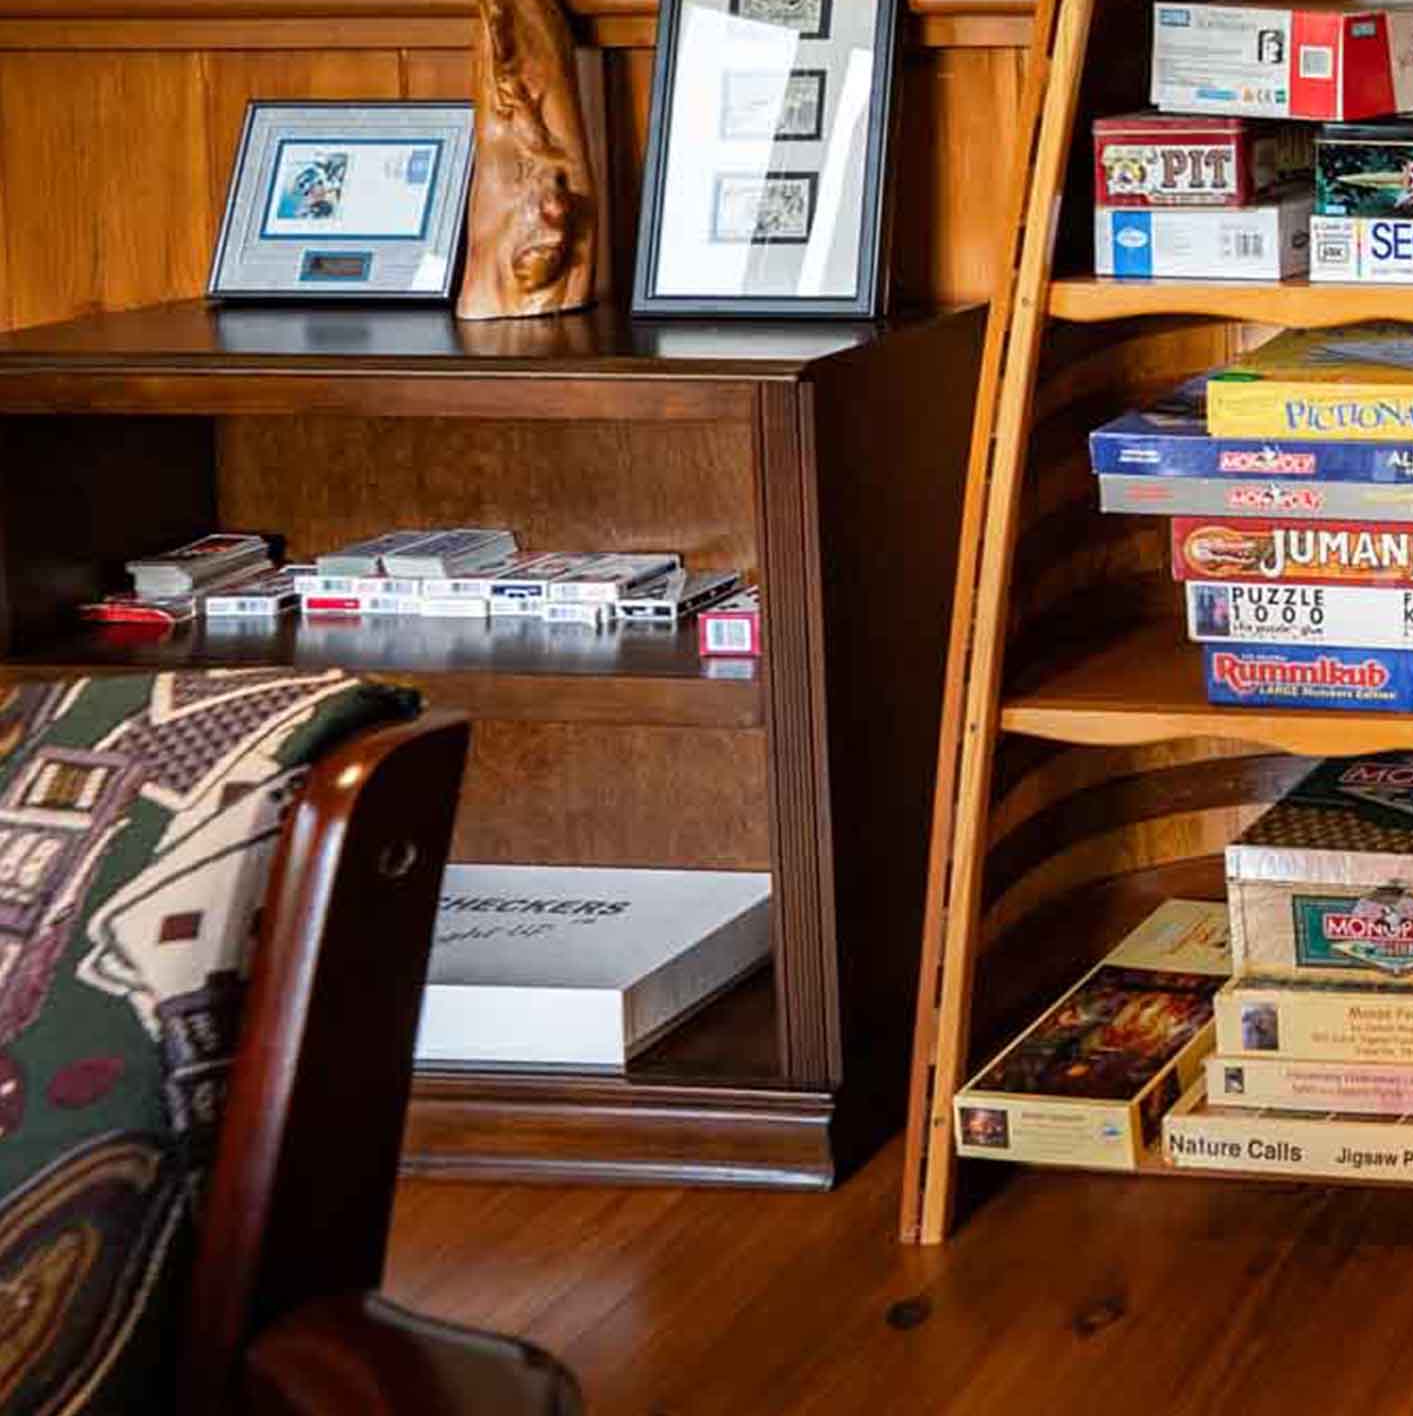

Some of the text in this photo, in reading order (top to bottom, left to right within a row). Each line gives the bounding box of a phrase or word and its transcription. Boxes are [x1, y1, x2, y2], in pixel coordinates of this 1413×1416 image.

[1160, 148, 1232, 188] PIT
[1232, 587, 1324, 606] PUZZLE
[1213, 653, 1390, 695] Rummikub
[1169, 1134, 1302, 1163] Nature Calls
[1336, 1147, 1398, 1170] Jigsaw
